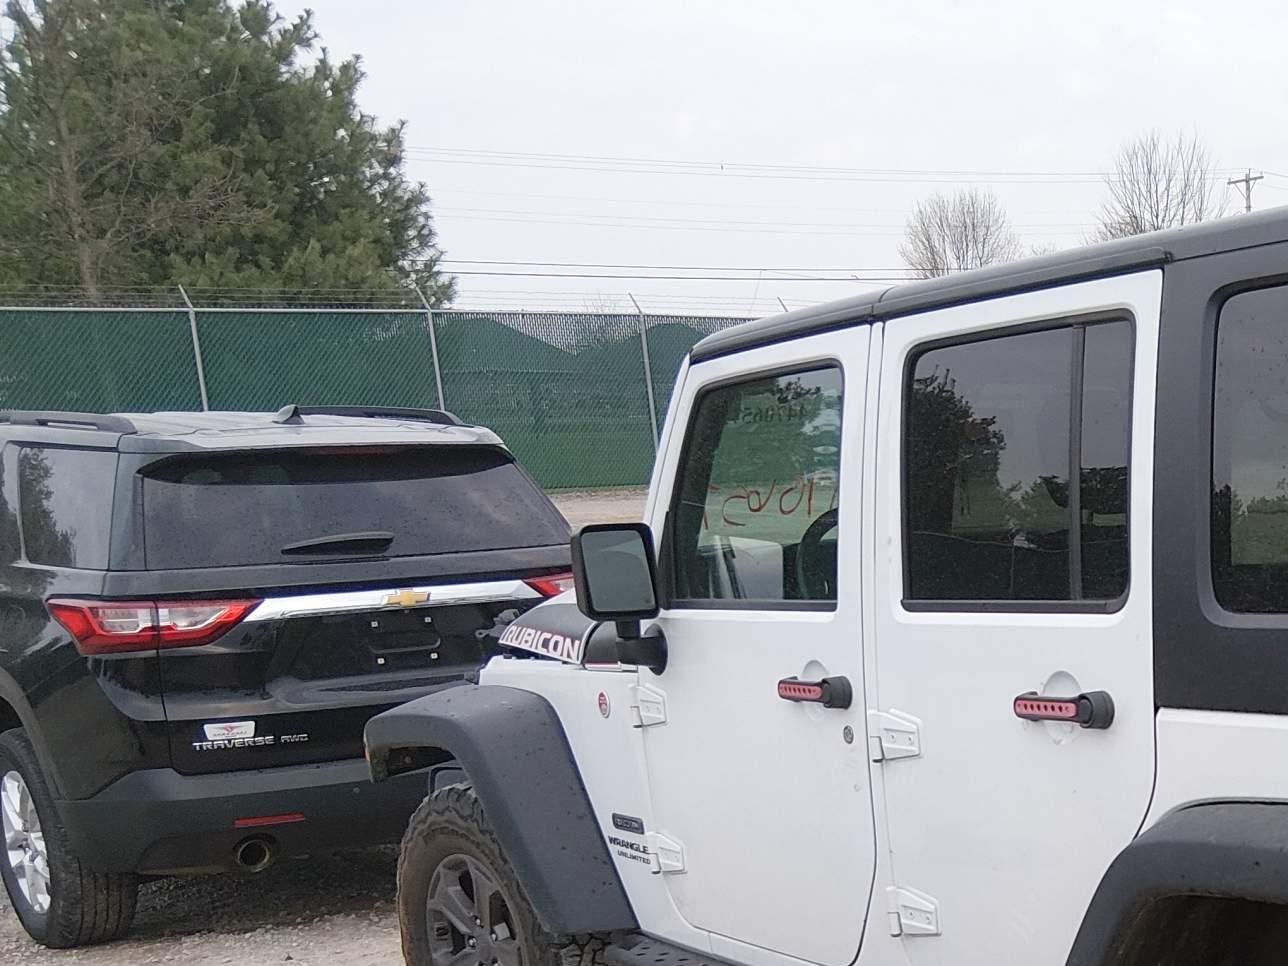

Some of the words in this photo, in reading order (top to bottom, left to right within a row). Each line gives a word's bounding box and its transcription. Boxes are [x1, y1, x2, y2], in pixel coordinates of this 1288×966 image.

[504, 625, 580, 660] RUBICON
[192, 736, 275, 751] TRAVERSE
[281, 733, 309, 743] AWD
[608, 836, 649, 854] WRANGLE
[617, 850, 652, 865] UNLIMITED
